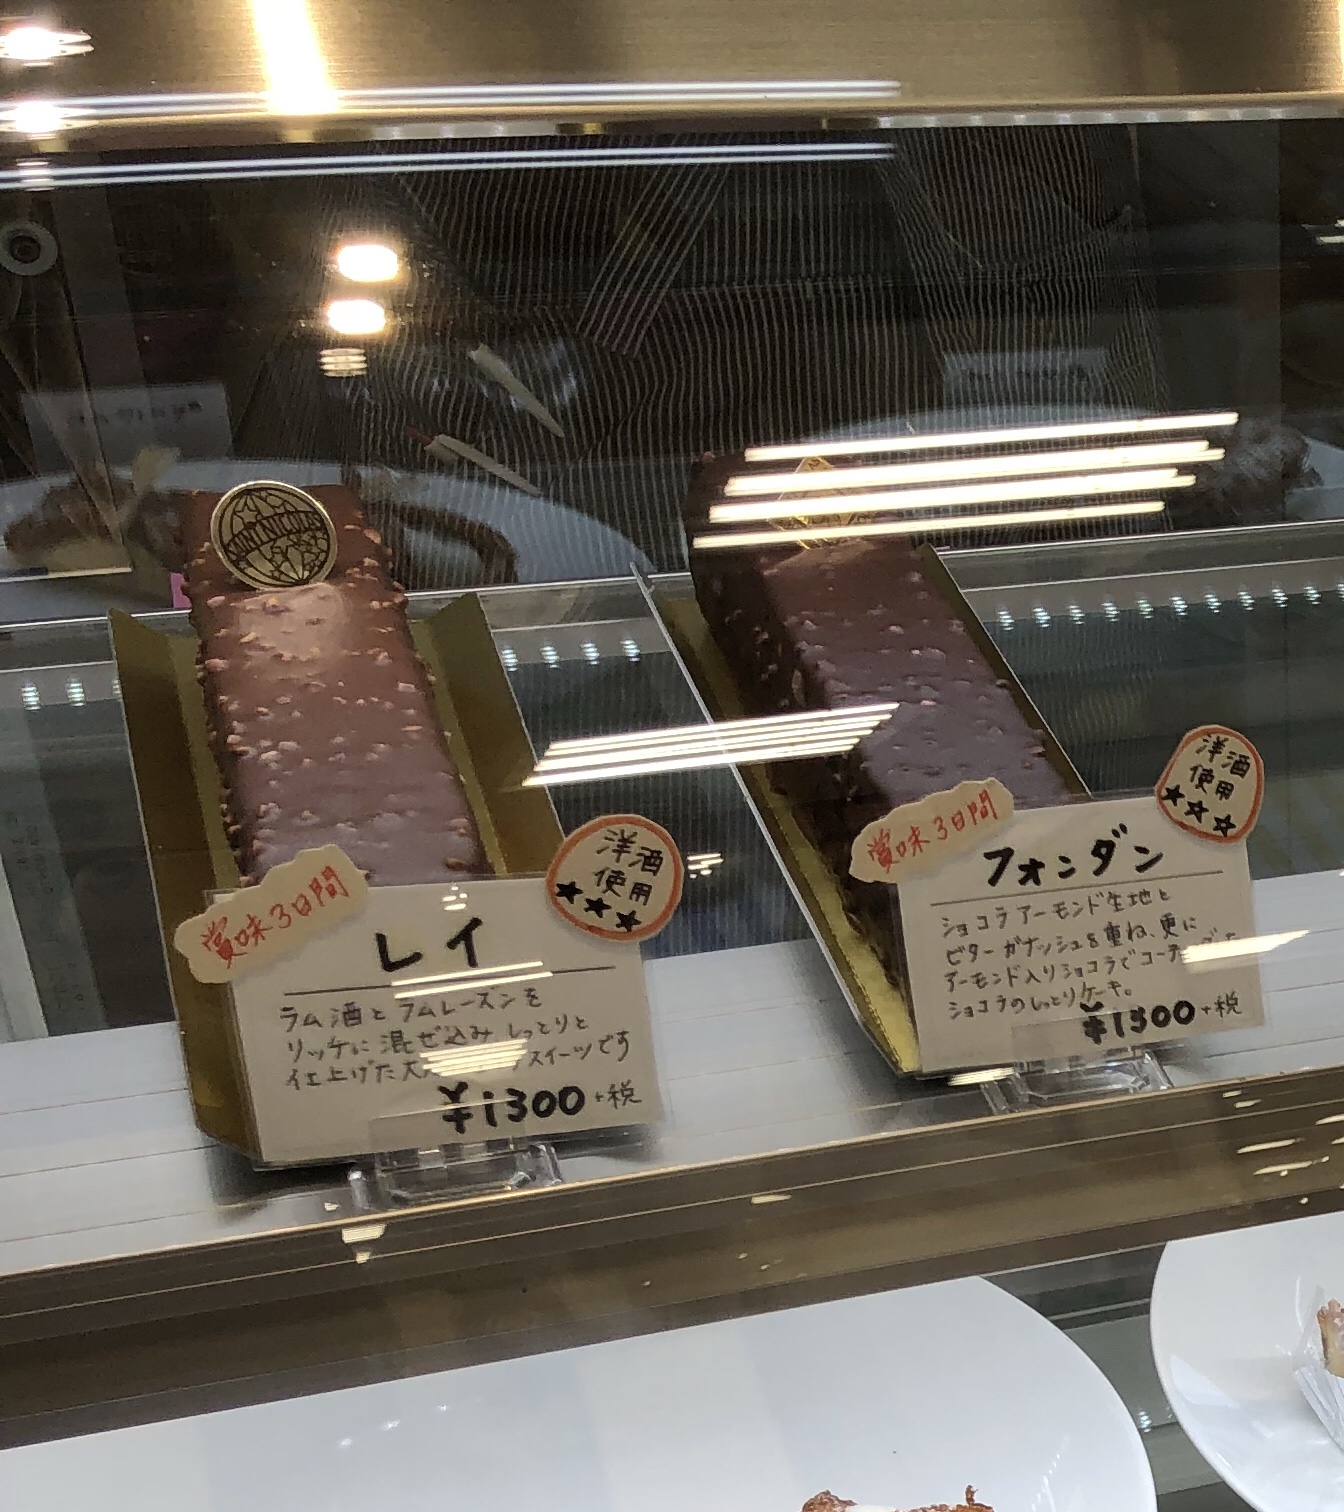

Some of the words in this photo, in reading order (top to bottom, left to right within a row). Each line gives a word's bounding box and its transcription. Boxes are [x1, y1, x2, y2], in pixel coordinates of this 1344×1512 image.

[1196, 735, 1251, 779] 洋酒
[1189, 764, 1235, 801] 使用
[597, 829, 664, 876] 洋酒
[982, 823, 1164, 887] フォンダン
[595, 867, 653, 907] 使用
[376, 916, 483, 973] レイ
[438, 1081, 586, 1133] ¥1300
